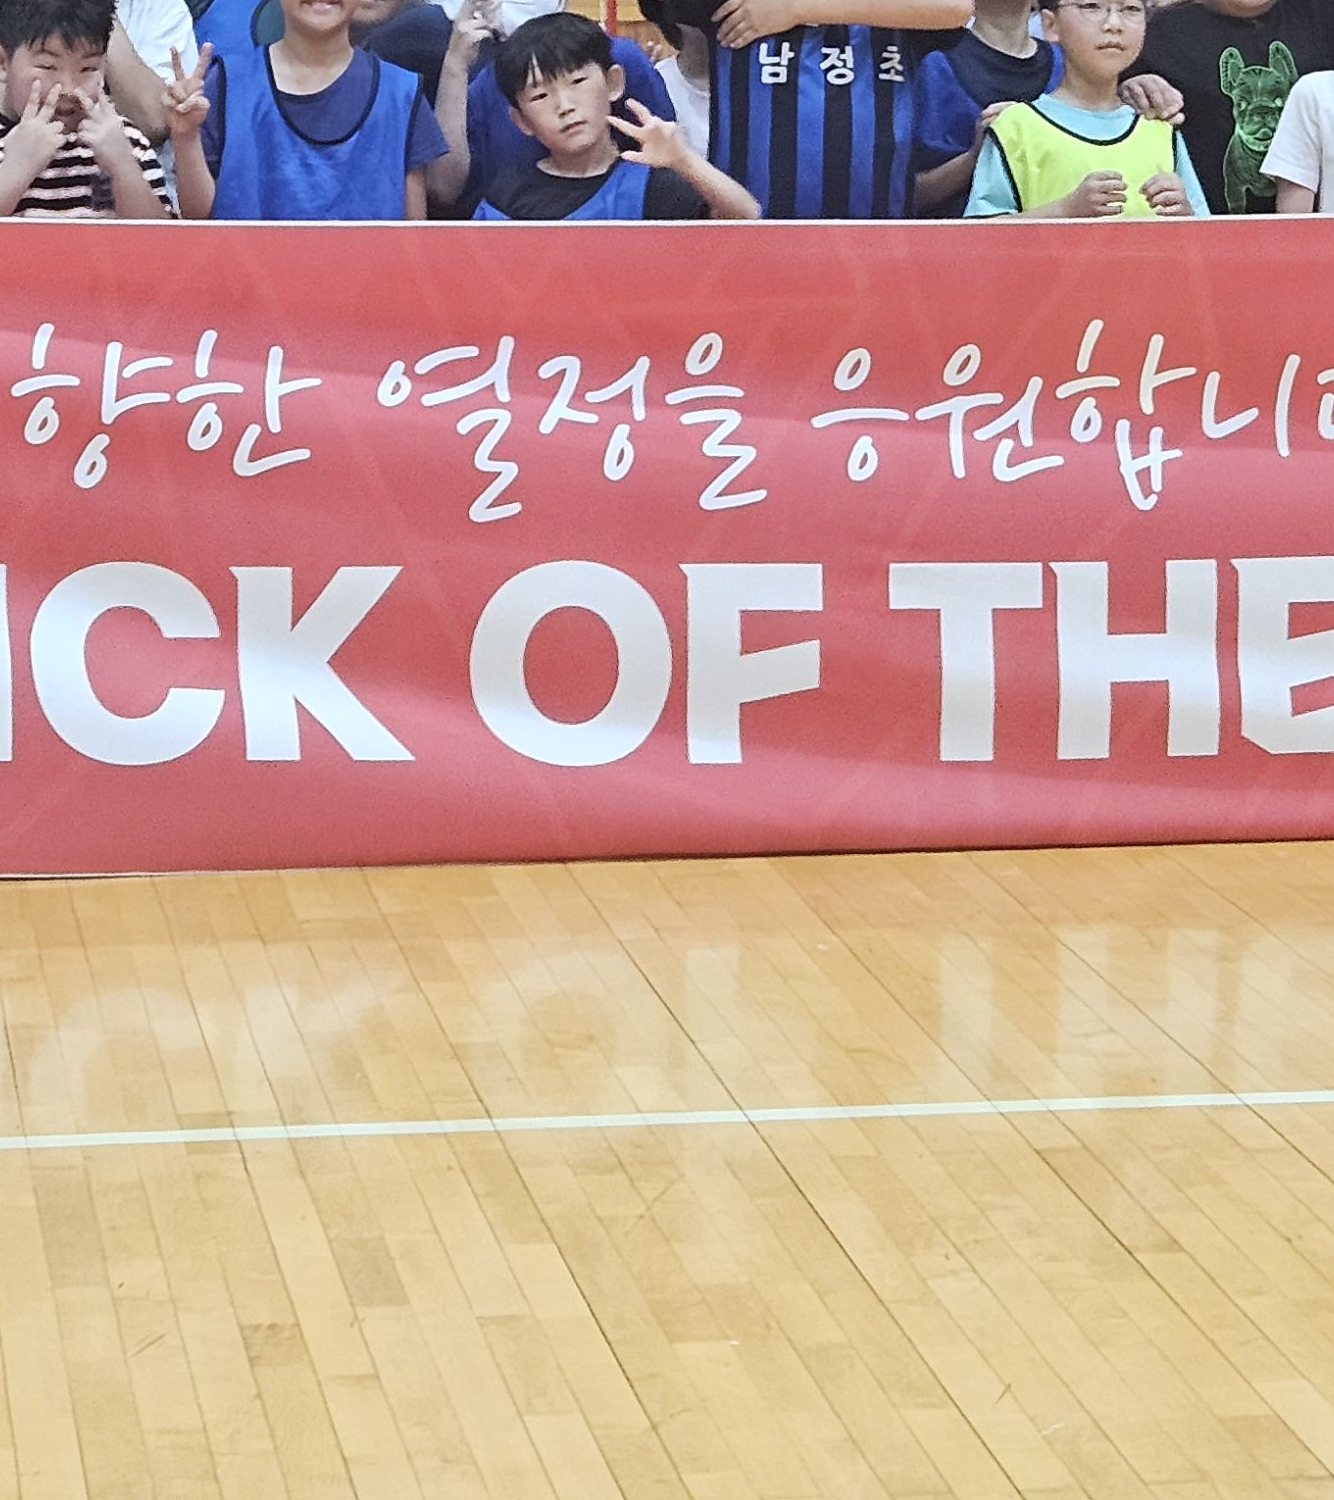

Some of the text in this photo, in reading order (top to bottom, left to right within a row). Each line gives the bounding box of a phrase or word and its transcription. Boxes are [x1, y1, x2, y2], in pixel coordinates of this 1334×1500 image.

[757, 41, 905, 85] 남정초
[10, 322, 323, 488] 향한
[376, 332, 769, 524] 열정을
[468, 558, 824, 767] OF
